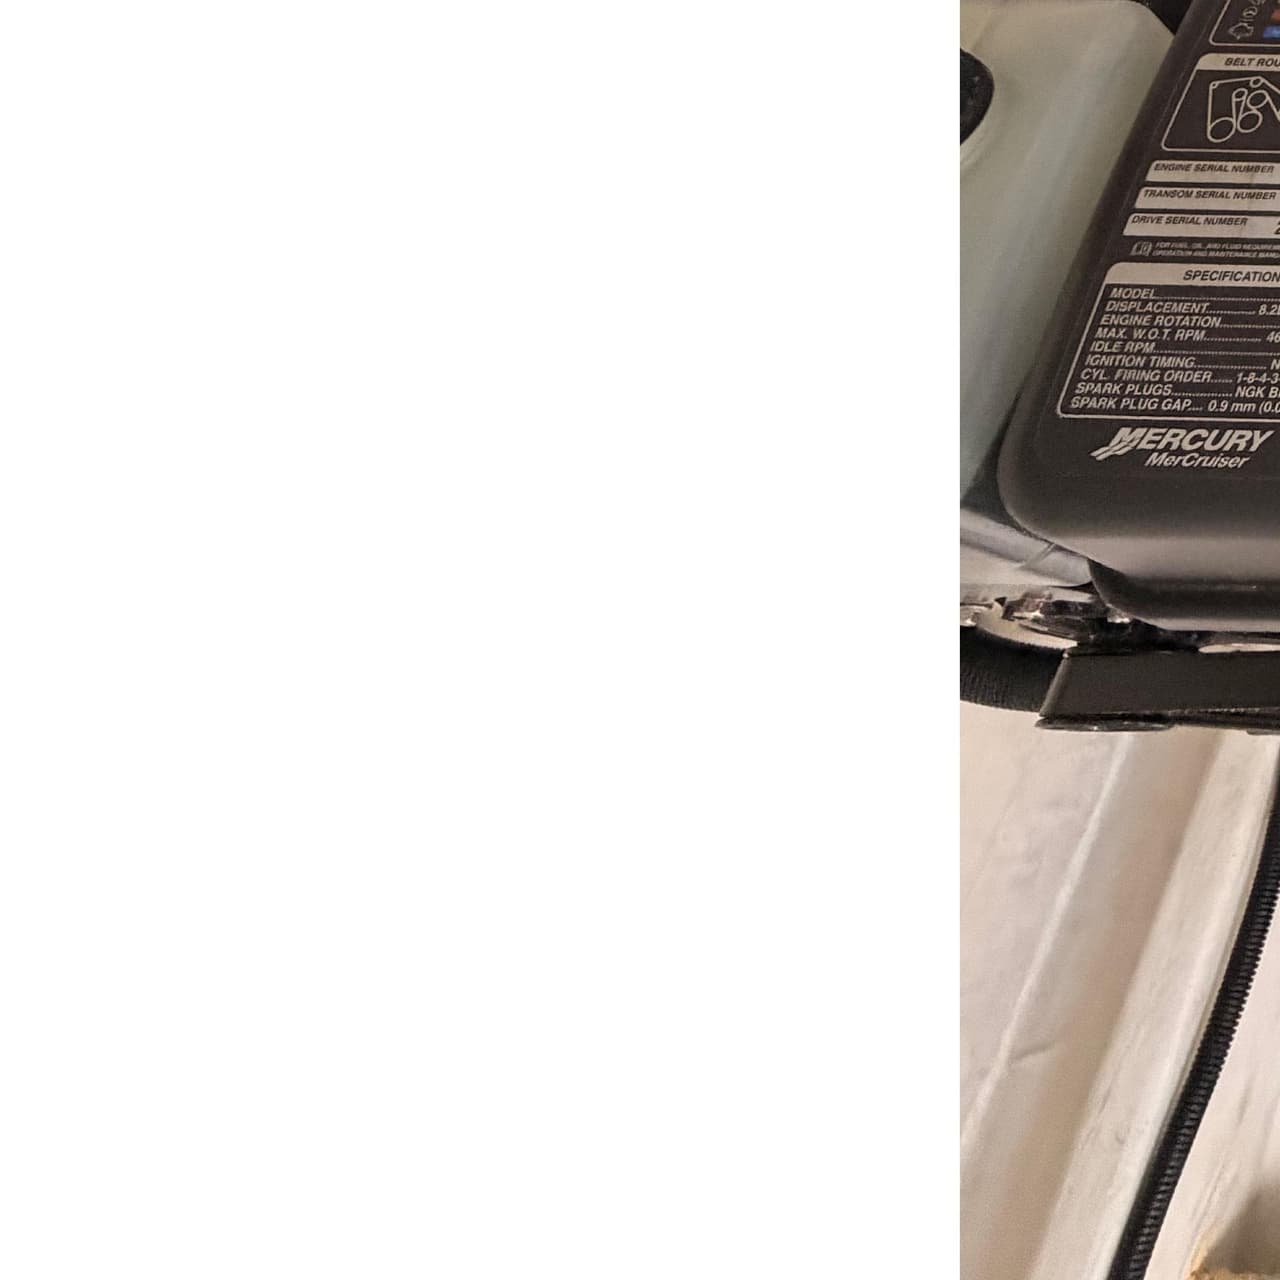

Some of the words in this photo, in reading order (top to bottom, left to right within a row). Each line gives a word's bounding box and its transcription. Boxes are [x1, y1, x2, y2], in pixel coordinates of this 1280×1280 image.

[1224, 57, 1256, 66] BELT
[1154, 163, 1193, 171] ENGINE
[1194, 164, 1229, 172] SERIAL
[1231, 165, 1274, 174] NUMBER
[1143, 189, 1194, 199] TRANSOM
[1194, 190, 1232, 199] SERIAL
[1233, 191, 1277, 200] NUMBER
[1131, 215, 1165, 224] DRIVE
[1165, 216, 1203, 225] SERIAL
[1203, 217, 1248, 226] NUMBER
[1110, 288, 1156, 299] MODEL
[1105, 301, 1210, 313] DISPLACEMENT
[1100, 314, 1152, 326] ENGINE
[1154, 316, 1222, 328] ROTATION
[1094, 328, 1128, 339] MAX.
[1133, 329, 1171, 341] W.O.T.
[1174, 330, 1206, 341] RPM
[1090, 341, 1124, 352] IDLE
[1124, 342, 1156, 353] RPM
[1085, 354, 1149, 366] IGNITION
[1149, 357, 1196, 368] TIMING
[1114, 369, 1161, 381] FIRING
[1163, 371, 1213, 382] ORDER
[1075, 382, 1124, 394] SPARK
[1125, 384, 1173, 395] PLUGS
[1235, 386, 1266, 398] NGK
[1071, 396, 1120, 409] SPARK
[1120, 398, 1159, 410] PLUG
[1161, 399, 1192, 411] GAP
[1207, 400, 1228, 412] 0.9
[1231, 402, 1256, 412] mm
[1096, 427, 1275, 455] MERCURY
[1144, 452, 1250, 468] MerCruiser
